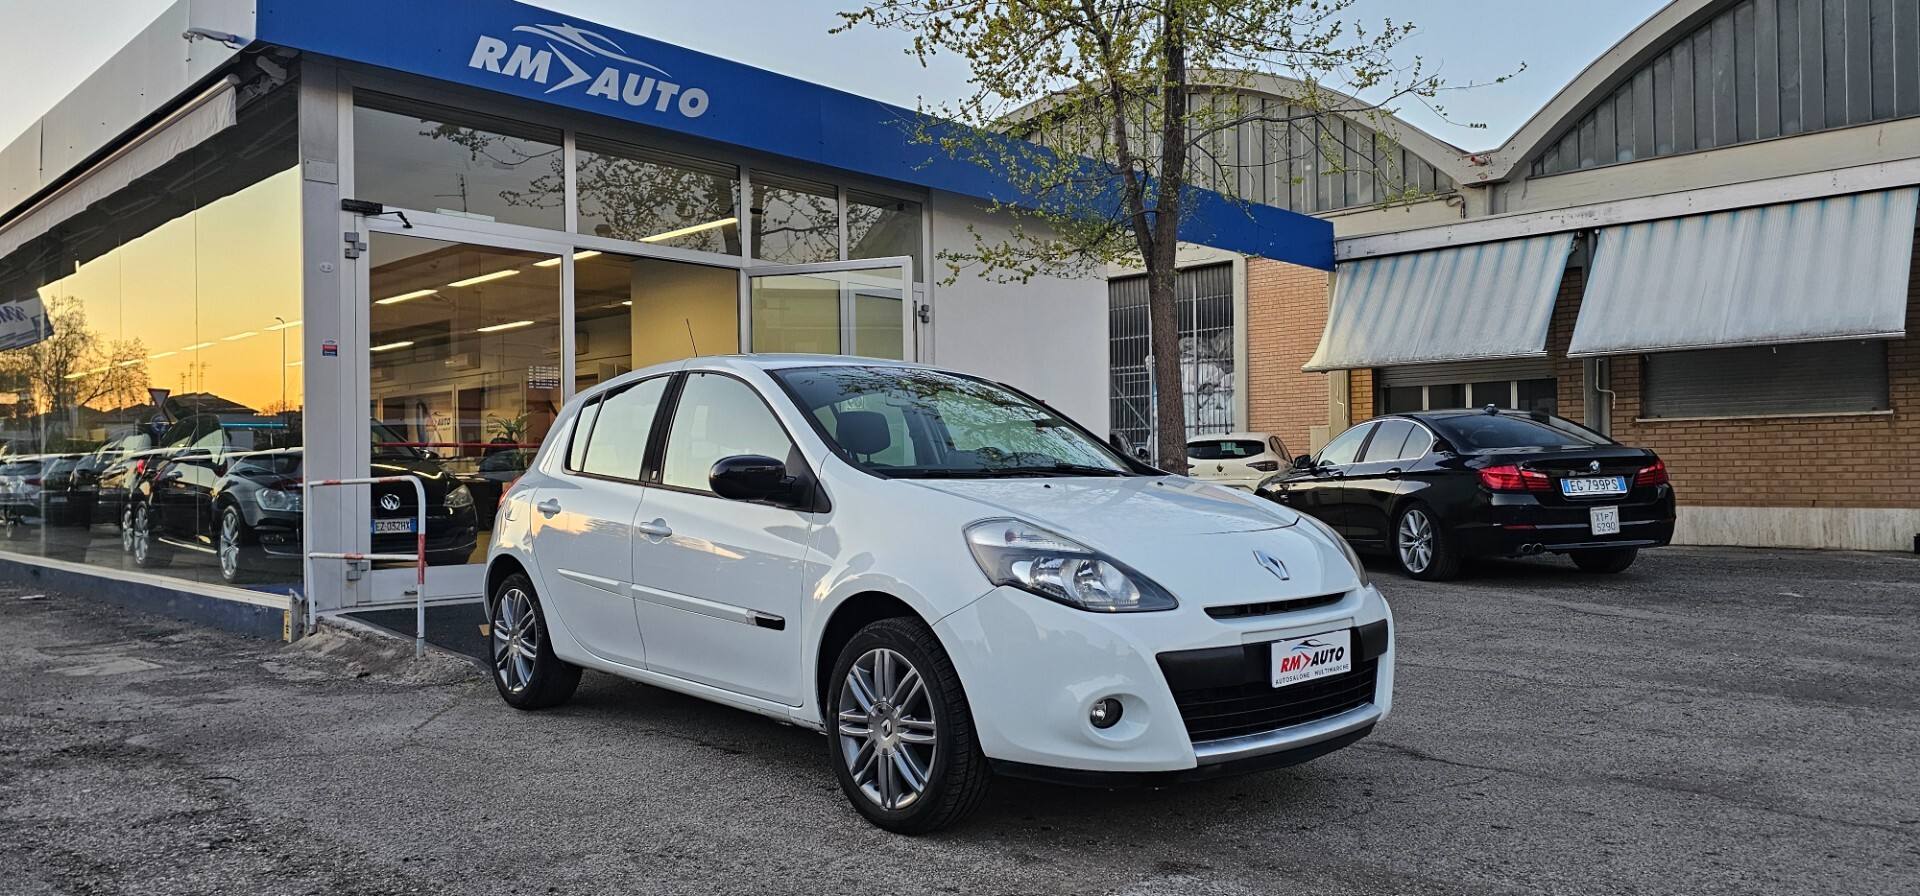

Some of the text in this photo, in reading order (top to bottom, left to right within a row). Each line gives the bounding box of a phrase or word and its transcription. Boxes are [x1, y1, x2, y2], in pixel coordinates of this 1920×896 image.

[1597, 521, 1616, 532] 5290
[1275, 663, 1350, 685] AUTOSALONE MULTIMARCHE
